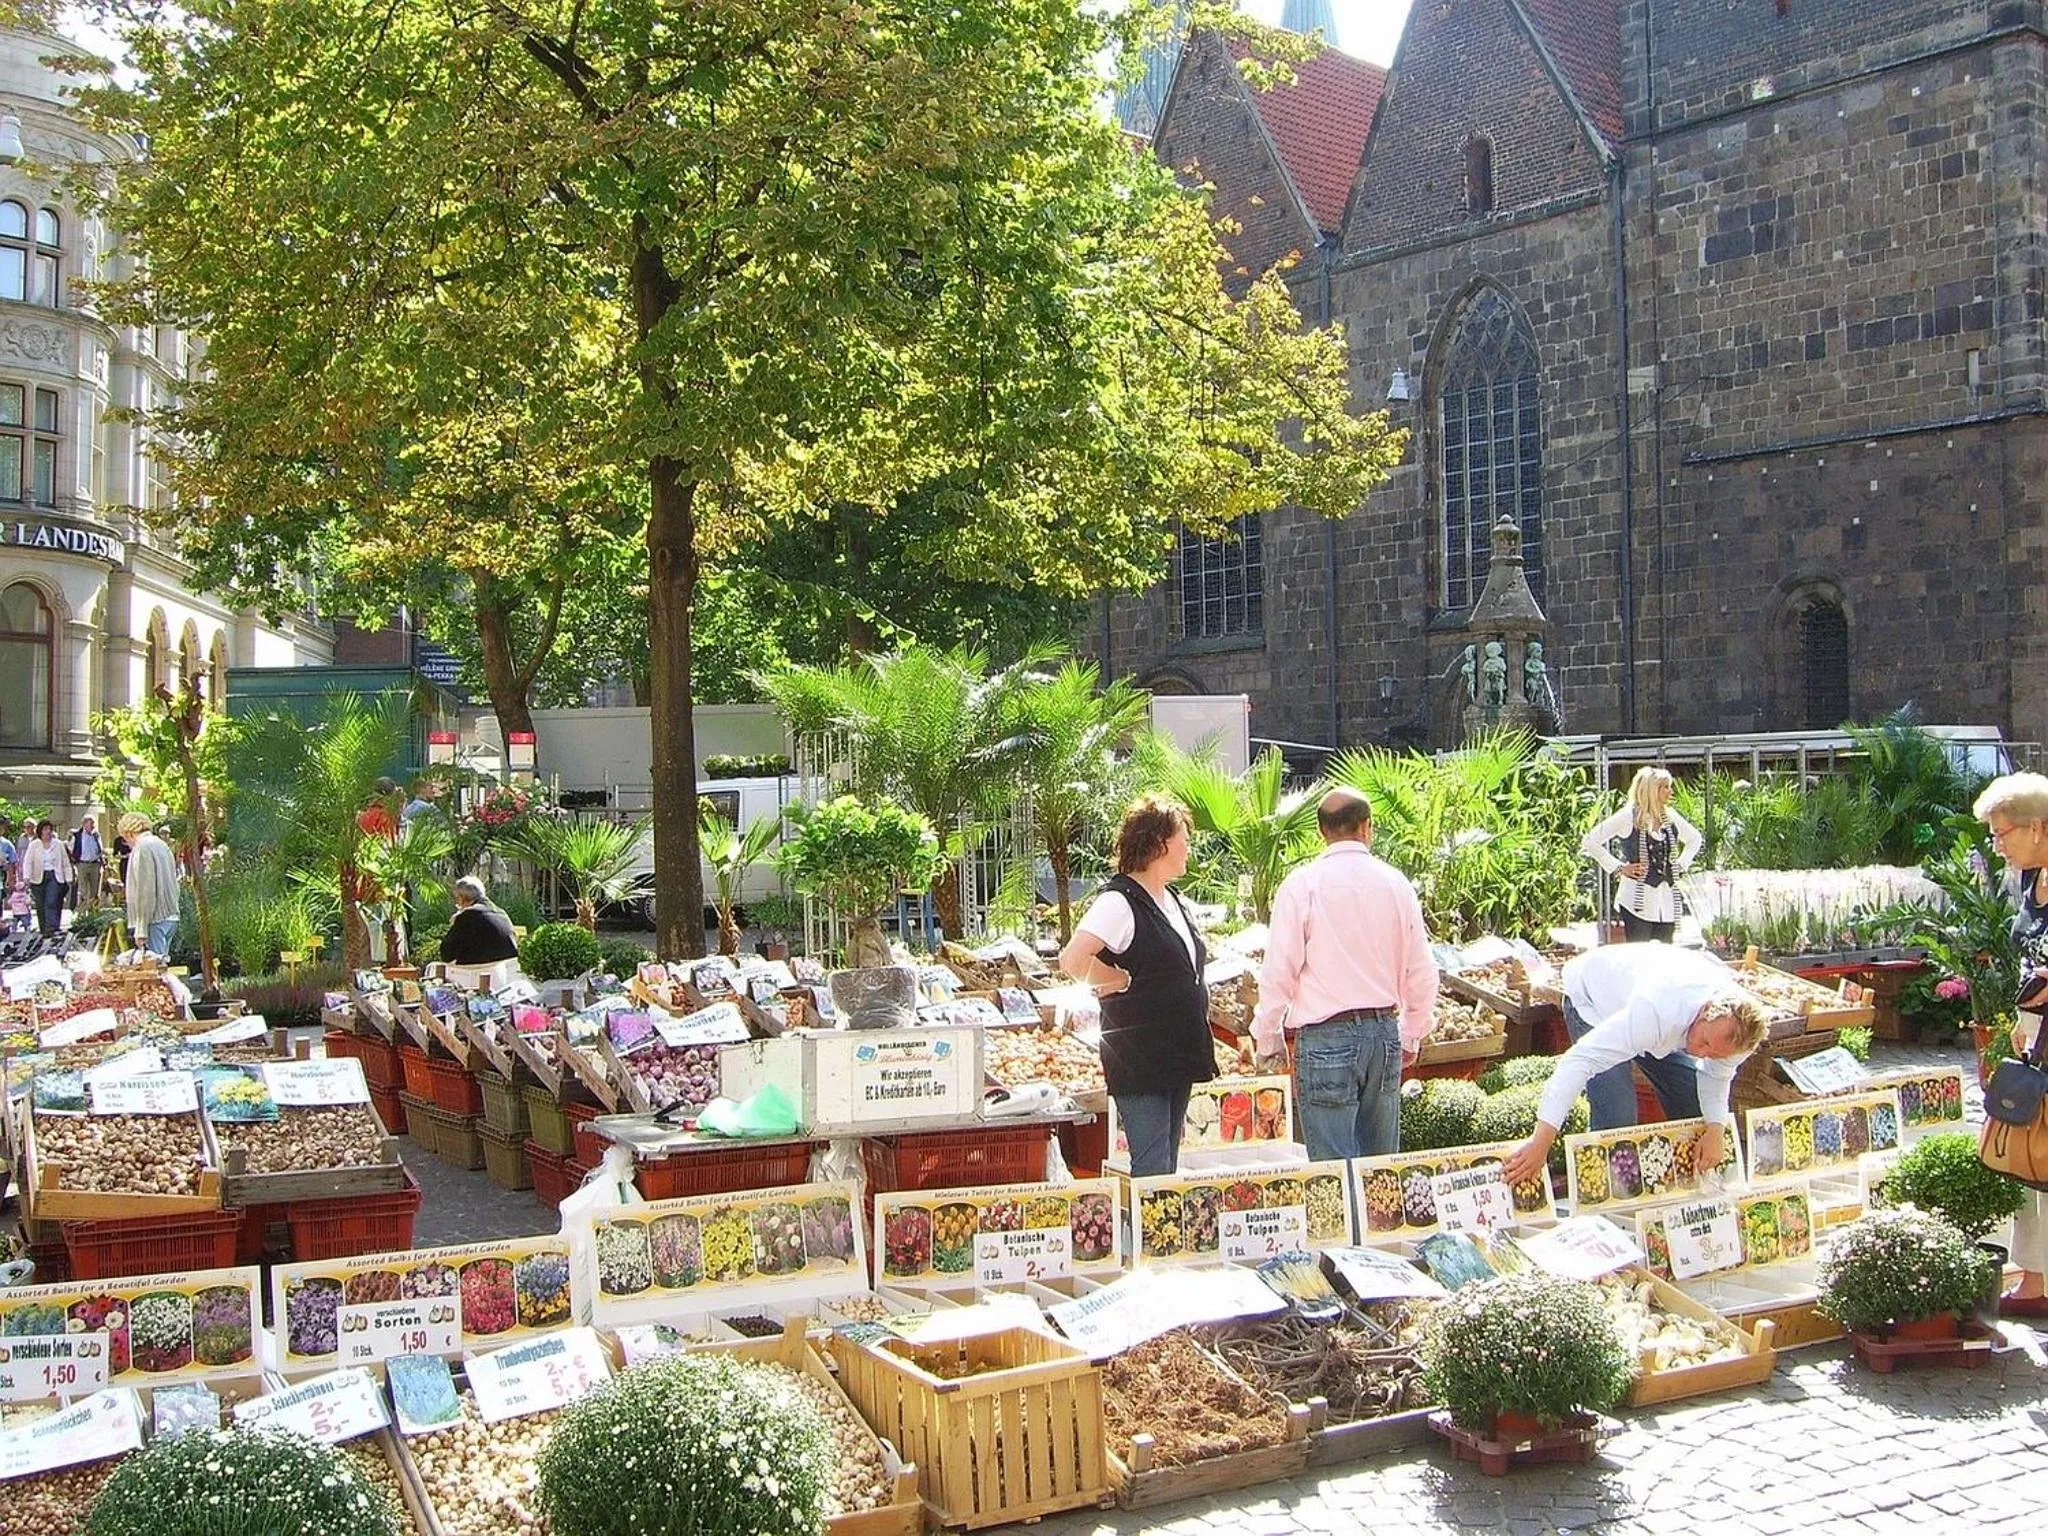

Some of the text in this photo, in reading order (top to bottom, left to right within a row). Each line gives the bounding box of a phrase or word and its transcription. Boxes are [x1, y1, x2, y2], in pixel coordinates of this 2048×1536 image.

[880, 1068, 932, 1081] Wir akzeptieren
[865, 1085, 874, 1100] EC
[933, 1081, 946, 1095] Euro
[650, 1201, 684, 1210] Assorted
[709, 1196, 722, 1205] for
[731, 1191, 767, 1201] Beautiful
[768, 1188, 797, 1198] Garden
[1245, 1211, 1280, 1223] Botanische
[1003, 1232, 1046, 1245] Botanische
[1247, 1224, 1280, 1237] Tulpen
[1007, 1245, 1042, 1259] Tulpen
[1266, 1238, 1283, 1255] 2,-
[346, 1257, 385, 1268] Assorted
[388, 1255, 411, 1264] Bulbs
[413, 1252, 427, 1262] for
[438, 1246, 478, 1257] Beautiful
[480, 1243, 511, 1254] Garden
[1026, 1261, 1046, 1279] 2,-
[6, 1287, 49, 1299] Assorted
[52, 1285, 78, 1295] Bulbs
[80, 1283, 96, 1293] for
[107, 1280, 150, 1290] Beautiful
[153, 1276, 187, 1286] Garden
[376, 1307, 416, 1317] verschiedene
[374, 1315, 422, 1329] Sorten
[12, 1337, 72, 1360] verschiedene Sorten
[400, 1331, 427, 1353] 1,50
[43, 1364, 76, 1388] 1,50
[308, 1400, 341, 1418] 2,-
[314, 1419, 350, 1436] 5,-
